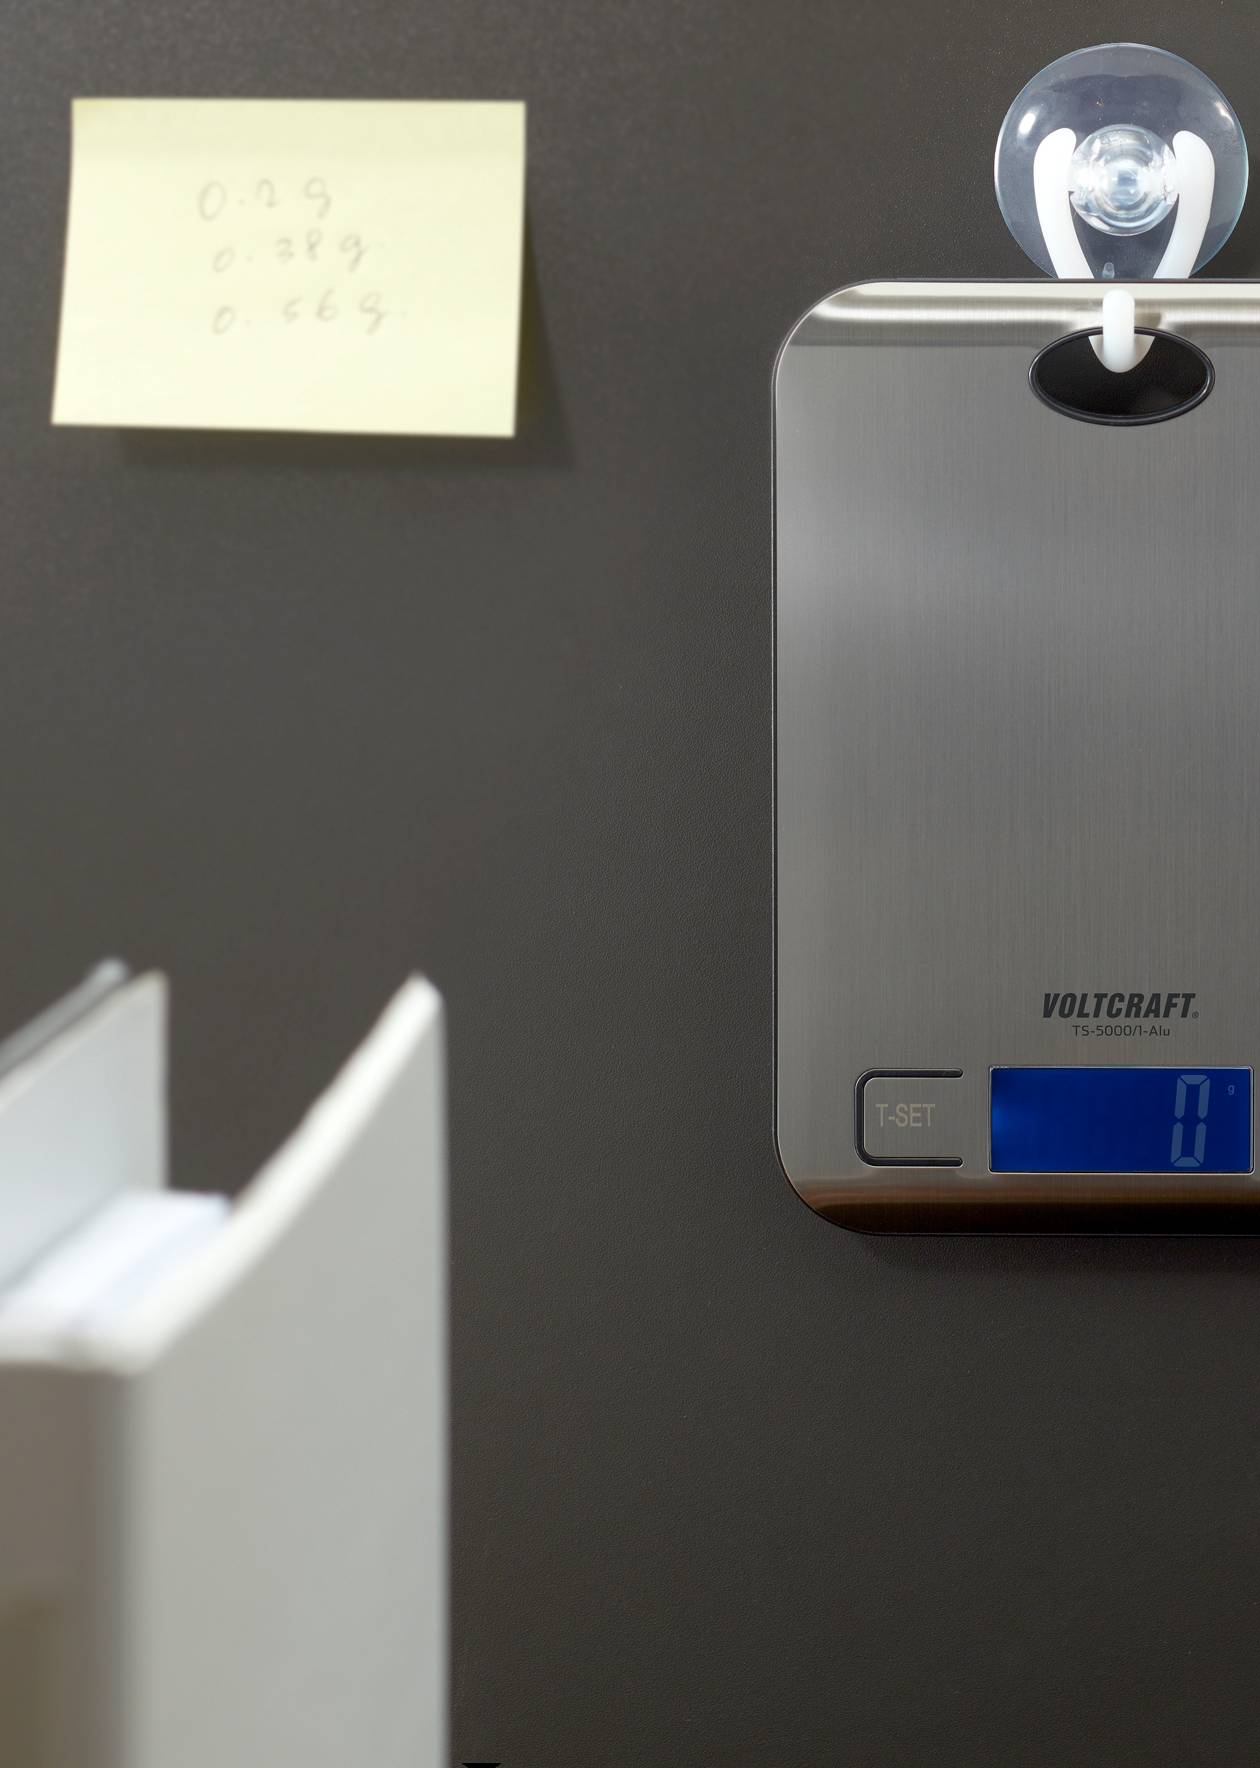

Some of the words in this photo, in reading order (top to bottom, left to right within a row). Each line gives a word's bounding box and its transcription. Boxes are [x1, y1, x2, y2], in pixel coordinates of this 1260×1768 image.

[1072, 1024, 1171, 1037] TS-5000/1-Alu
[875, 1103, 936, 1127] T-SET
[1170, 1074, 1211, 1168] 0
[1227, 1084, 1236, 1096] g
